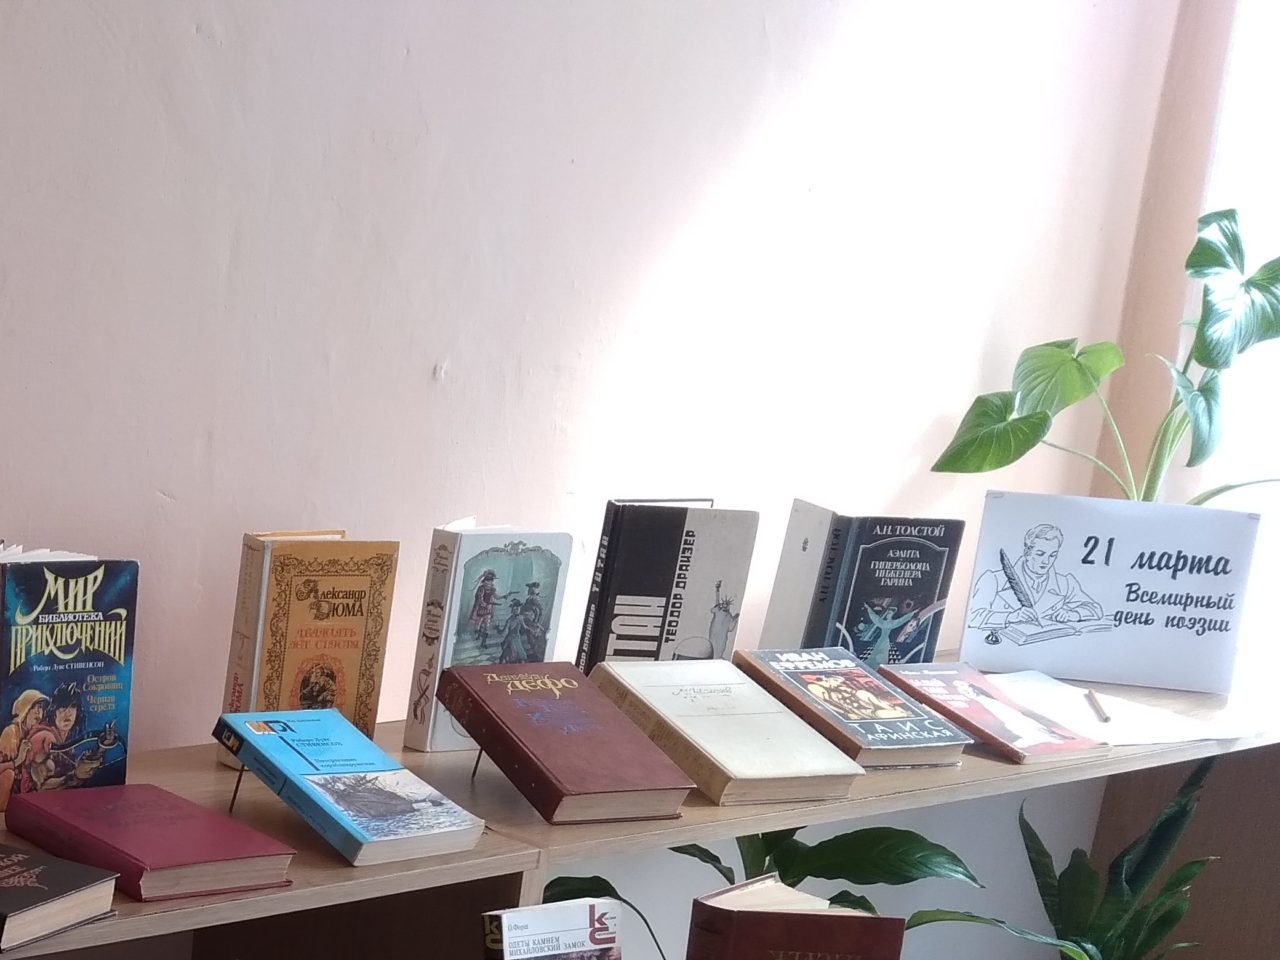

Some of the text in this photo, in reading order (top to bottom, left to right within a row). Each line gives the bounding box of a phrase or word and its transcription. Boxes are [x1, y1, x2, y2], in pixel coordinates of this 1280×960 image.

[895, 524, 946, 537] ТОЛСТОЙ
[886, 549, 920, 558] АЭЛИТА
[1081, 535, 1232, 580] 21 марта
[592, 535, 608, 593] ТИТАН
[664, 530, 696, 643] ТЕОДОР ДРАЙЗЕР
[1125, 582, 1235, 611] Всемирный
[38, 612, 104, 623] БИБЛИОТЕКА
[1113, 610, 1231, 636] день поэзии
[9, 608, 128, 675] ПРИКЛЮЧЕНИЙ
[775, 653, 826, 661] ИВАН
[867, 730, 954, 741] АФИНСКАЯ
[563, 940, 586, 950] ЗАМОК
